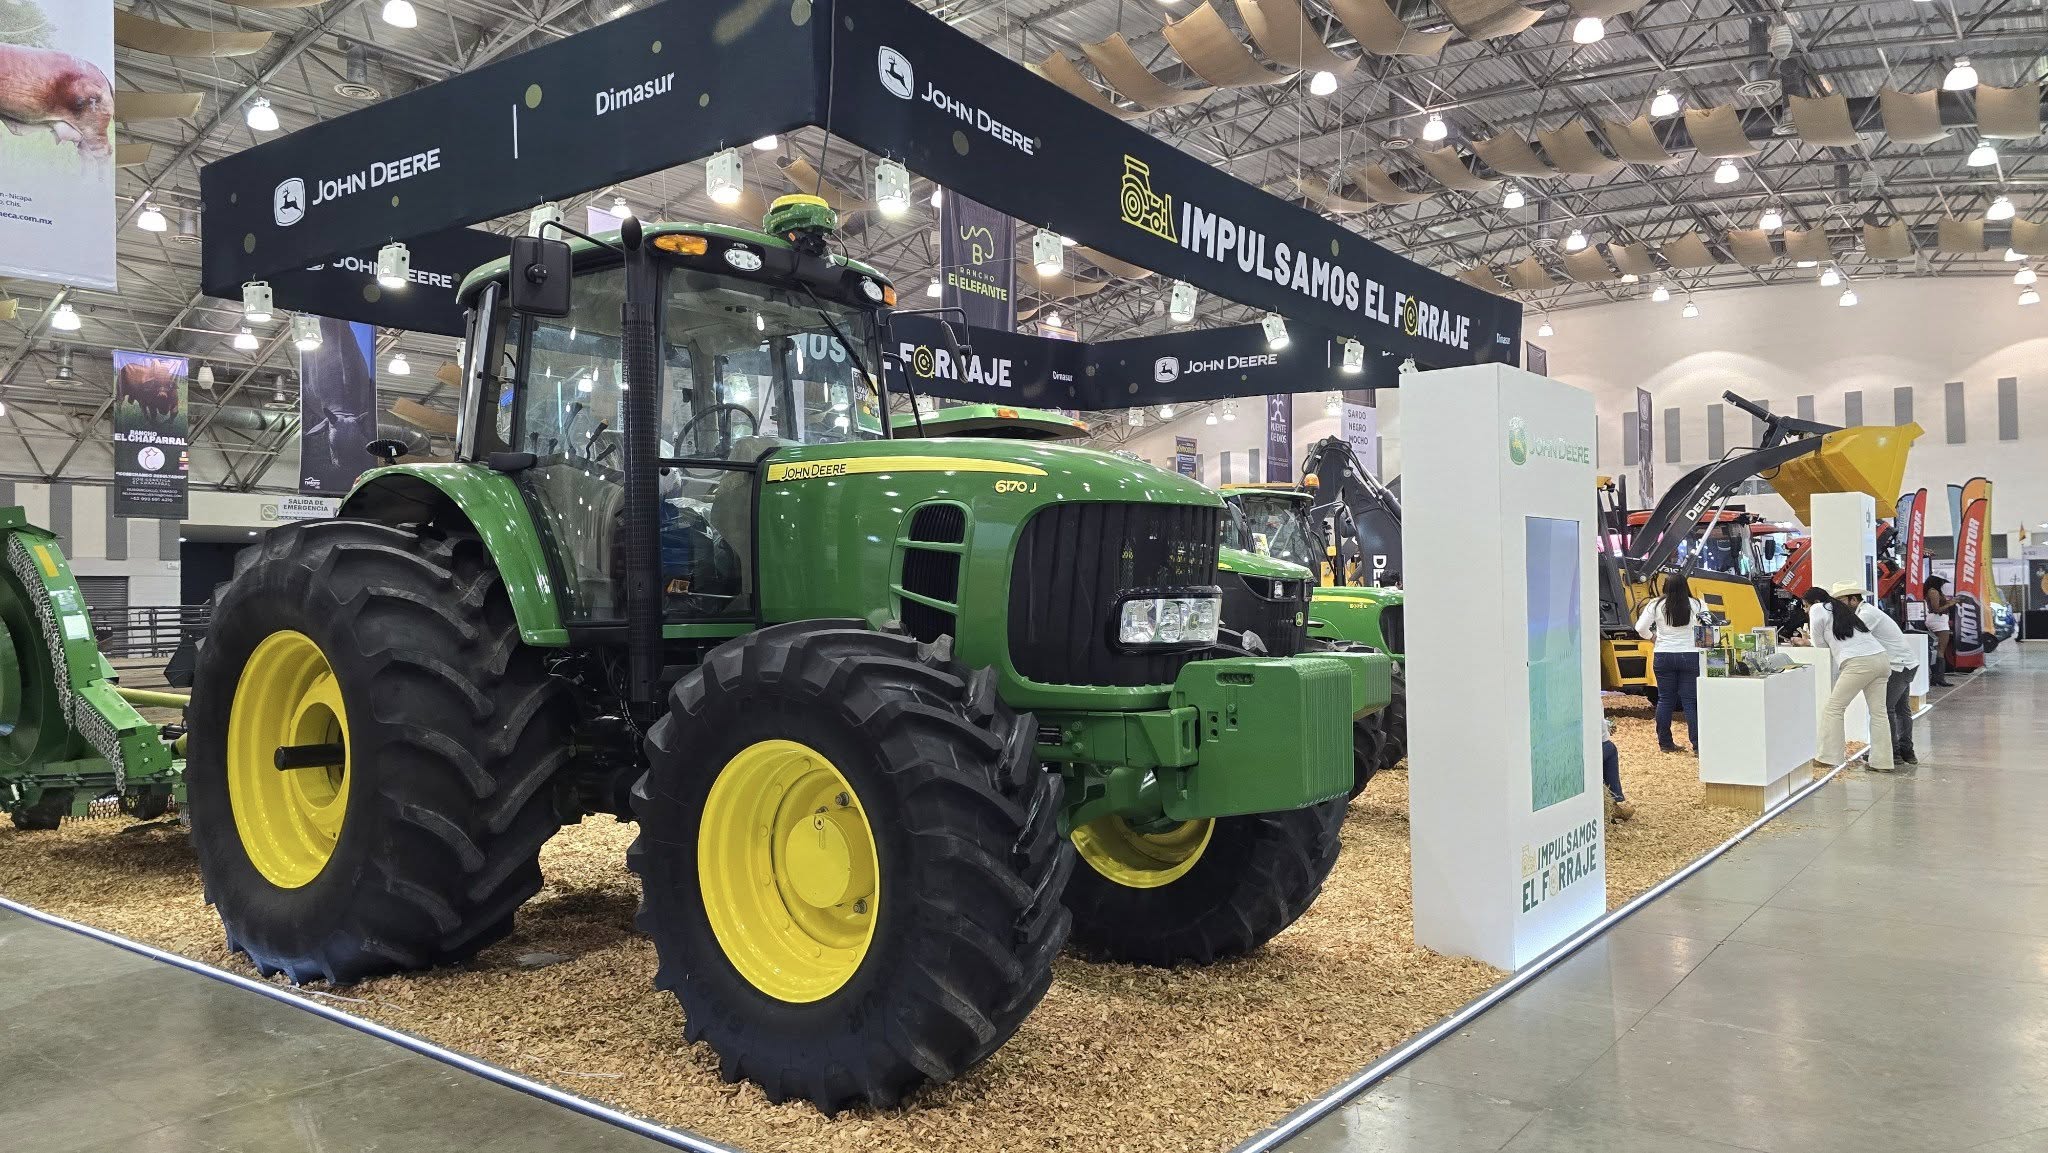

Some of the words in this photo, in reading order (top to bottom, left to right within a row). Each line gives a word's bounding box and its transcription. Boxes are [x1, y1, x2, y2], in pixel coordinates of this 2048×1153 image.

[596, 72, 675, 116] Dimasur
[921, 81, 973, 125] JOHN
[977, 108, 1034, 156] DEERE
[312, 170, 366, 206] JOHN
[370, 147, 441, 188] DEERE
[1180, 200, 1360, 311] IMPULSAMOS
[1364, 279, 1390, 325] EL
[408, 268, 453, 289] EERE
[960, 266, 995, 283] RANCHO
[948, 272, 959, 288] EL
[960, 276, 1008, 302] ELEFANTE
[1183, 359, 1225, 374] JOHN
[1227, 353, 1278, 370] DEERE
[1347, 409, 1367, 420] SARDO
[130, 429, 157, 437] RANCHO
[1348, 422, 1367, 433] NEGRO
[114, 432, 128, 442] EL
[128, 434, 188, 446] CHAPARRAL
[1348, 434, 1369, 445] MOCHO
[781, 466, 810, 480] JOHN
[811, 463, 847, 477] DEERE
[994, 479, 1028, 493] 6170
[1029, 482, 1037, 493] J
[283, 504, 329, 512] EMERGENCIA
[288, 498, 314, 506] SALIDA
[1684, 482, 1721, 522] DEERE
[1910, 509, 1923, 586] TRACTOR
[1962, 517, 1980, 584] TRACTOR
[1781, 570, 1796, 587] KIOTI
[1960, 602, 1979, 645] KIOTI
[1537, 818, 1597, 871] IMPULSAMOS
[1522, 877, 1539, 914] EL
